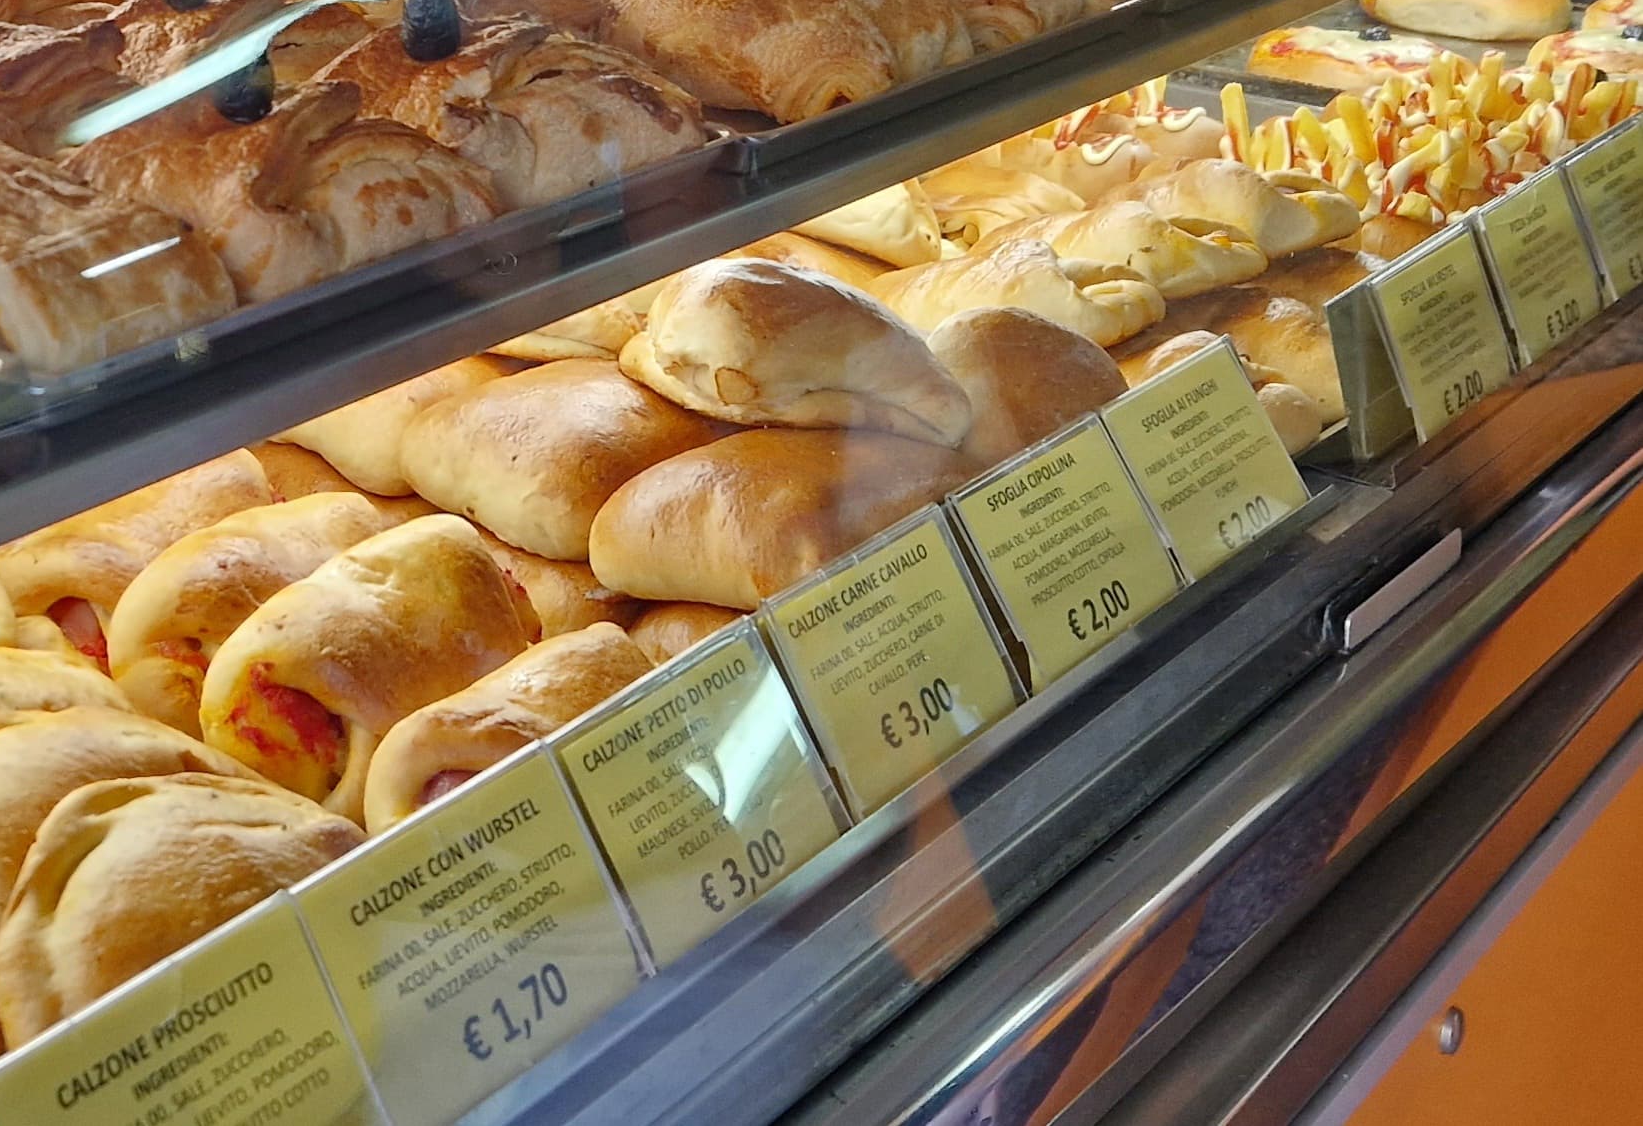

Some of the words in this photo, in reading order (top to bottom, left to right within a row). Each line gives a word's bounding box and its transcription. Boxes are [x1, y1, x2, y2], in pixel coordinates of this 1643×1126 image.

[1140, 401, 1178, 433] SFOGLIA
[1174, 395, 1188, 413] AI
[1184, 377, 1219, 407] FUNGHI
[1444, 389, 1455, 416] €
[1453, 369, 1483, 408] 2,00
[985, 477, 1029, 513] SFOGLIA
[1025, 449, 1077, 489] CIPOLLINA
[1018, 484, 1066, 519] INGREDIENTI:
[1218, 520, 1236, 550] €
[786, 595, 842, 640] CALZONE
[839, 571, 880, 608] CARNE
[877, 541, 929, 584] CAVALLO
[842, 592, 897, 635] INGREDIENTI:
[1068, 608, 1086, 640] €
[1083, 580, 1130, 631] 2,00
[809, 651, 843, 681] FARINA
[875, 609, 909, 640] ACQUA,
[905, 586, 946, 621] STRUTTO,
[829, 663, 866, 696] LIEVITO,
[862, 634, 911, 674] ZUCCHERO,
[907, 618, 936, 645] CARNE
[933, 611, 946, 629] DI
[867, 662, 908, 697] CAVALLO,
[580, 720, 647, 774] CALZONE
[643, 693, 689, 734] PETTO
[685, 683, 705, 707] DI
[701, 656, 748, 696] POLLO
[881, 713, 902, 749] €
[898, 678, 953, 735] 3,00
[606, 783, 647, 819] FARINA
[627, 797, 671, 836] LIEVITO,
[347, 864, 428, 929] CALZONE
[424, 840, 466, 881] CON
[462, 794, 541, 857] WURSTEL
[676, 827, 714, 860] POLLO,
[701, 872, 725, 913] €
[722, 828, 786, 897] 3,00
[356, 950, 404, 991] FARINA
[423, 916, 457, 948] SALE,
[454, 873, 523, 928] ZUCCHERO,
[519, 839, 577, 887] STRUTTO,
[418, 856, 499, 919] INGREDIENTI:
[394, 954, 446, 999] ACQUA,
[443, 923, 494, 967] LIEVITO,
[490, 876, 566, 936] POMODORO,
[422, 947, 506, 1013] MOZZARELLA,
[503, 911, 560, 960] WURSTEL
[53, 1034, 151, 1111] CALZONE
[149, 958, 275, 1052] PROSCIUTTO
[463, 1014, 492, 1061] €
[492, 962, 568, 1043] 1,70
[130, 1027, 231, 1102] INGREDIENTI:
[209, 1023, 291, 1087] ZUCCHERO,
[250, 1025, 341, 1096] POMODORO,
[282, 1064, 332, 1110] COTTO
